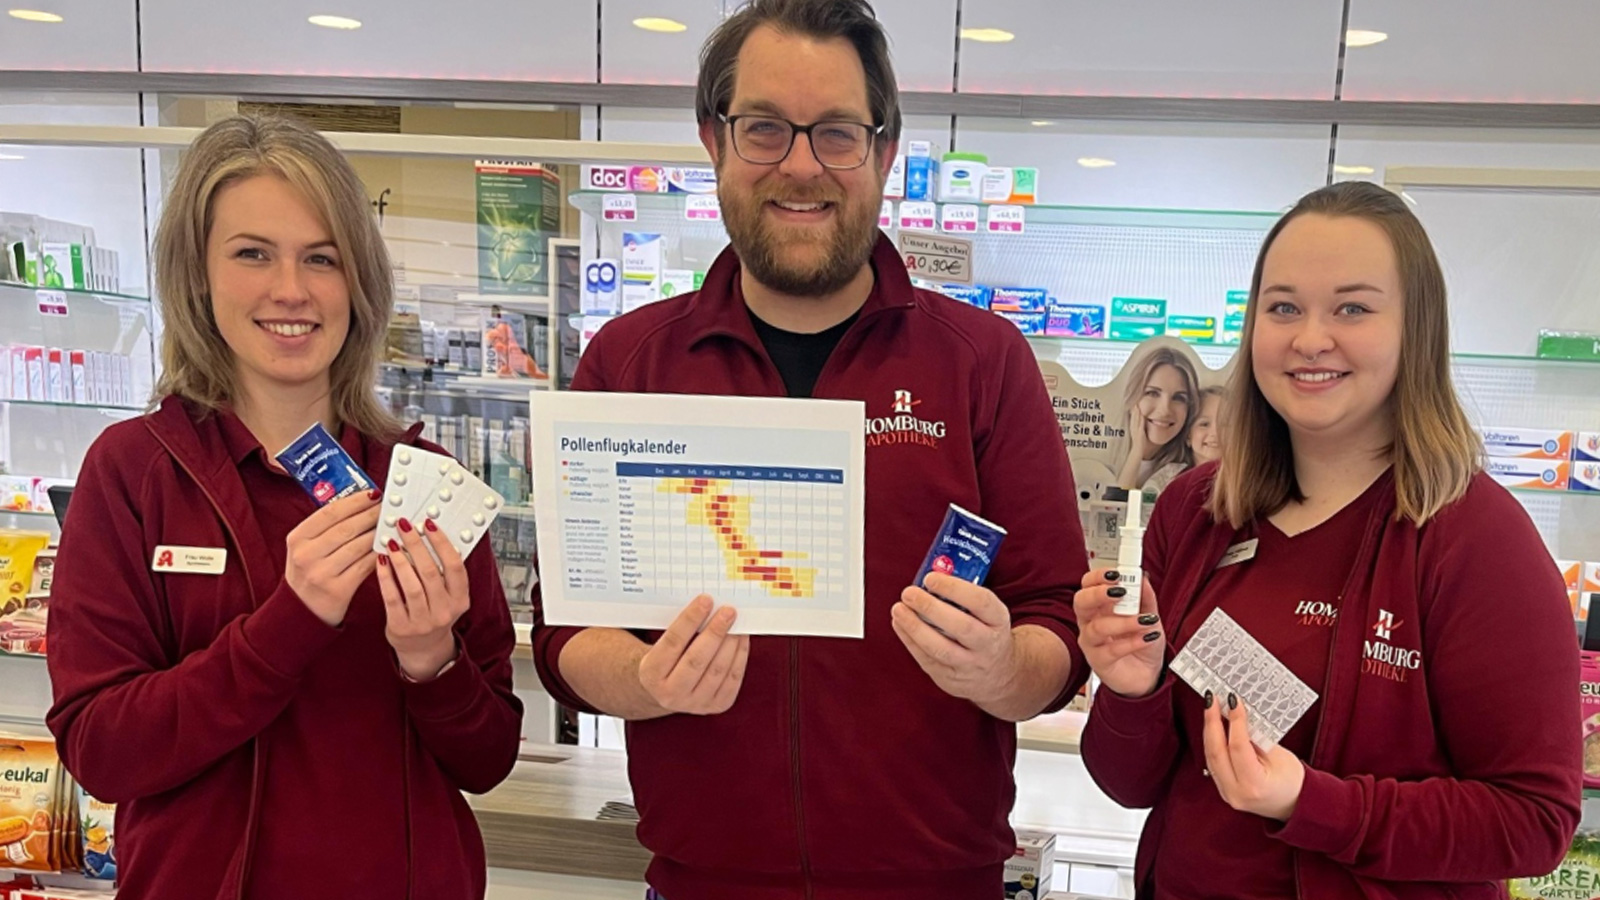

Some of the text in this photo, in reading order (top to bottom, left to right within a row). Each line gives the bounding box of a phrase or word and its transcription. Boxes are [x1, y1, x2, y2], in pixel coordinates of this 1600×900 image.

[592, 167, 626, 186] doc
[902, 236, 968, 256] Unser Angebot
[1121, 302, 1160, 315] ASPIRIN
[1052, 396, 1101, 411] Ein Stück
[1055, 411, 1105, 423] esundheit
[1073, 424, 1090, 436] Sie
[1092, 424, 1102, 437] &
[1104, 425, 1126, 438] Ihre
[561, 437, 687, 456] Pollenflugkalender
[867, 431, 938, 449] APOTHEKE
[1064, 438, 1108, 449] enschen
[1362, 640, 1420, 670] MBURG
[1361, 659, 1408, 682] OTHEKE
[4, 767, 49, 783] eukal
[1540, 888, 1590, 899] GARTEN
